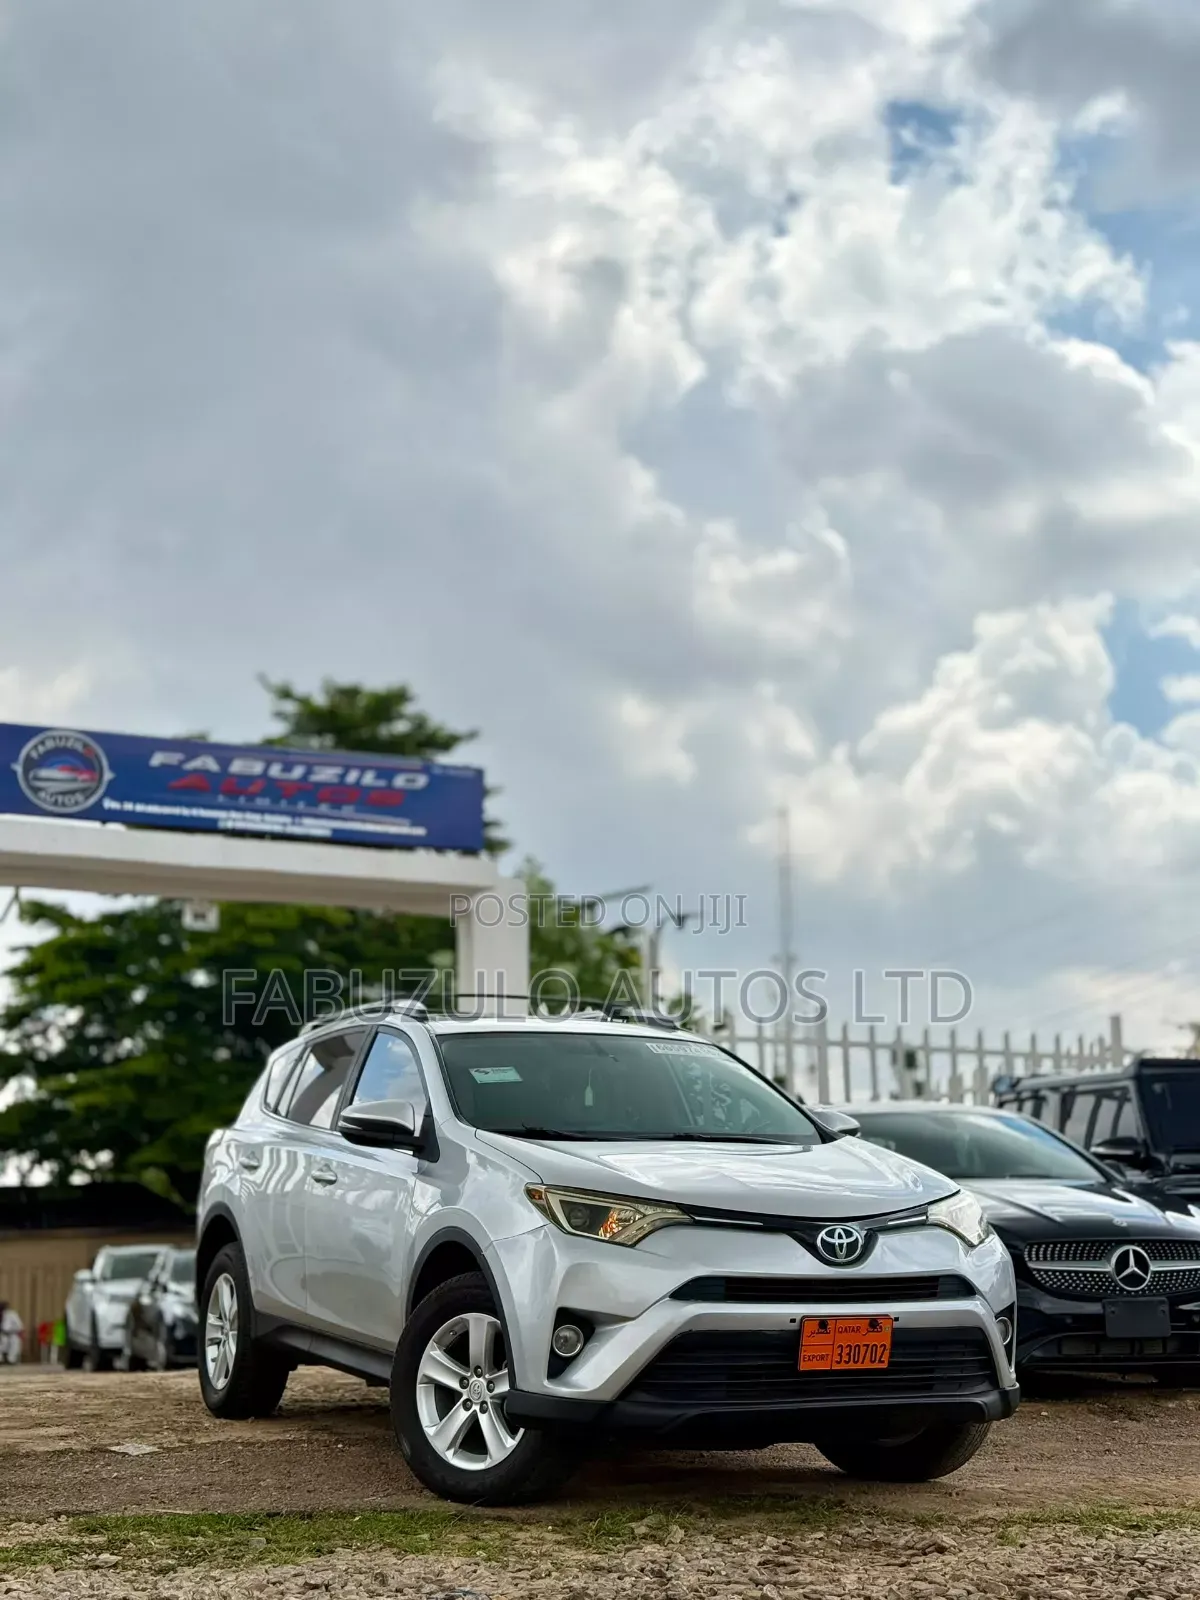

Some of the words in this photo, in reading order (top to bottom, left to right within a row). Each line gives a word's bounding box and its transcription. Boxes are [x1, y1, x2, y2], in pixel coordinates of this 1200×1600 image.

[148, 751, 429, 790] FABUZILO
[168, 773, 406, 807] AUTOS
[837, 1325, 861, 1334] QATAR
[803, 1353, 830, 1362] EXPORT
[835, 1343, 887, 1364] 330702
